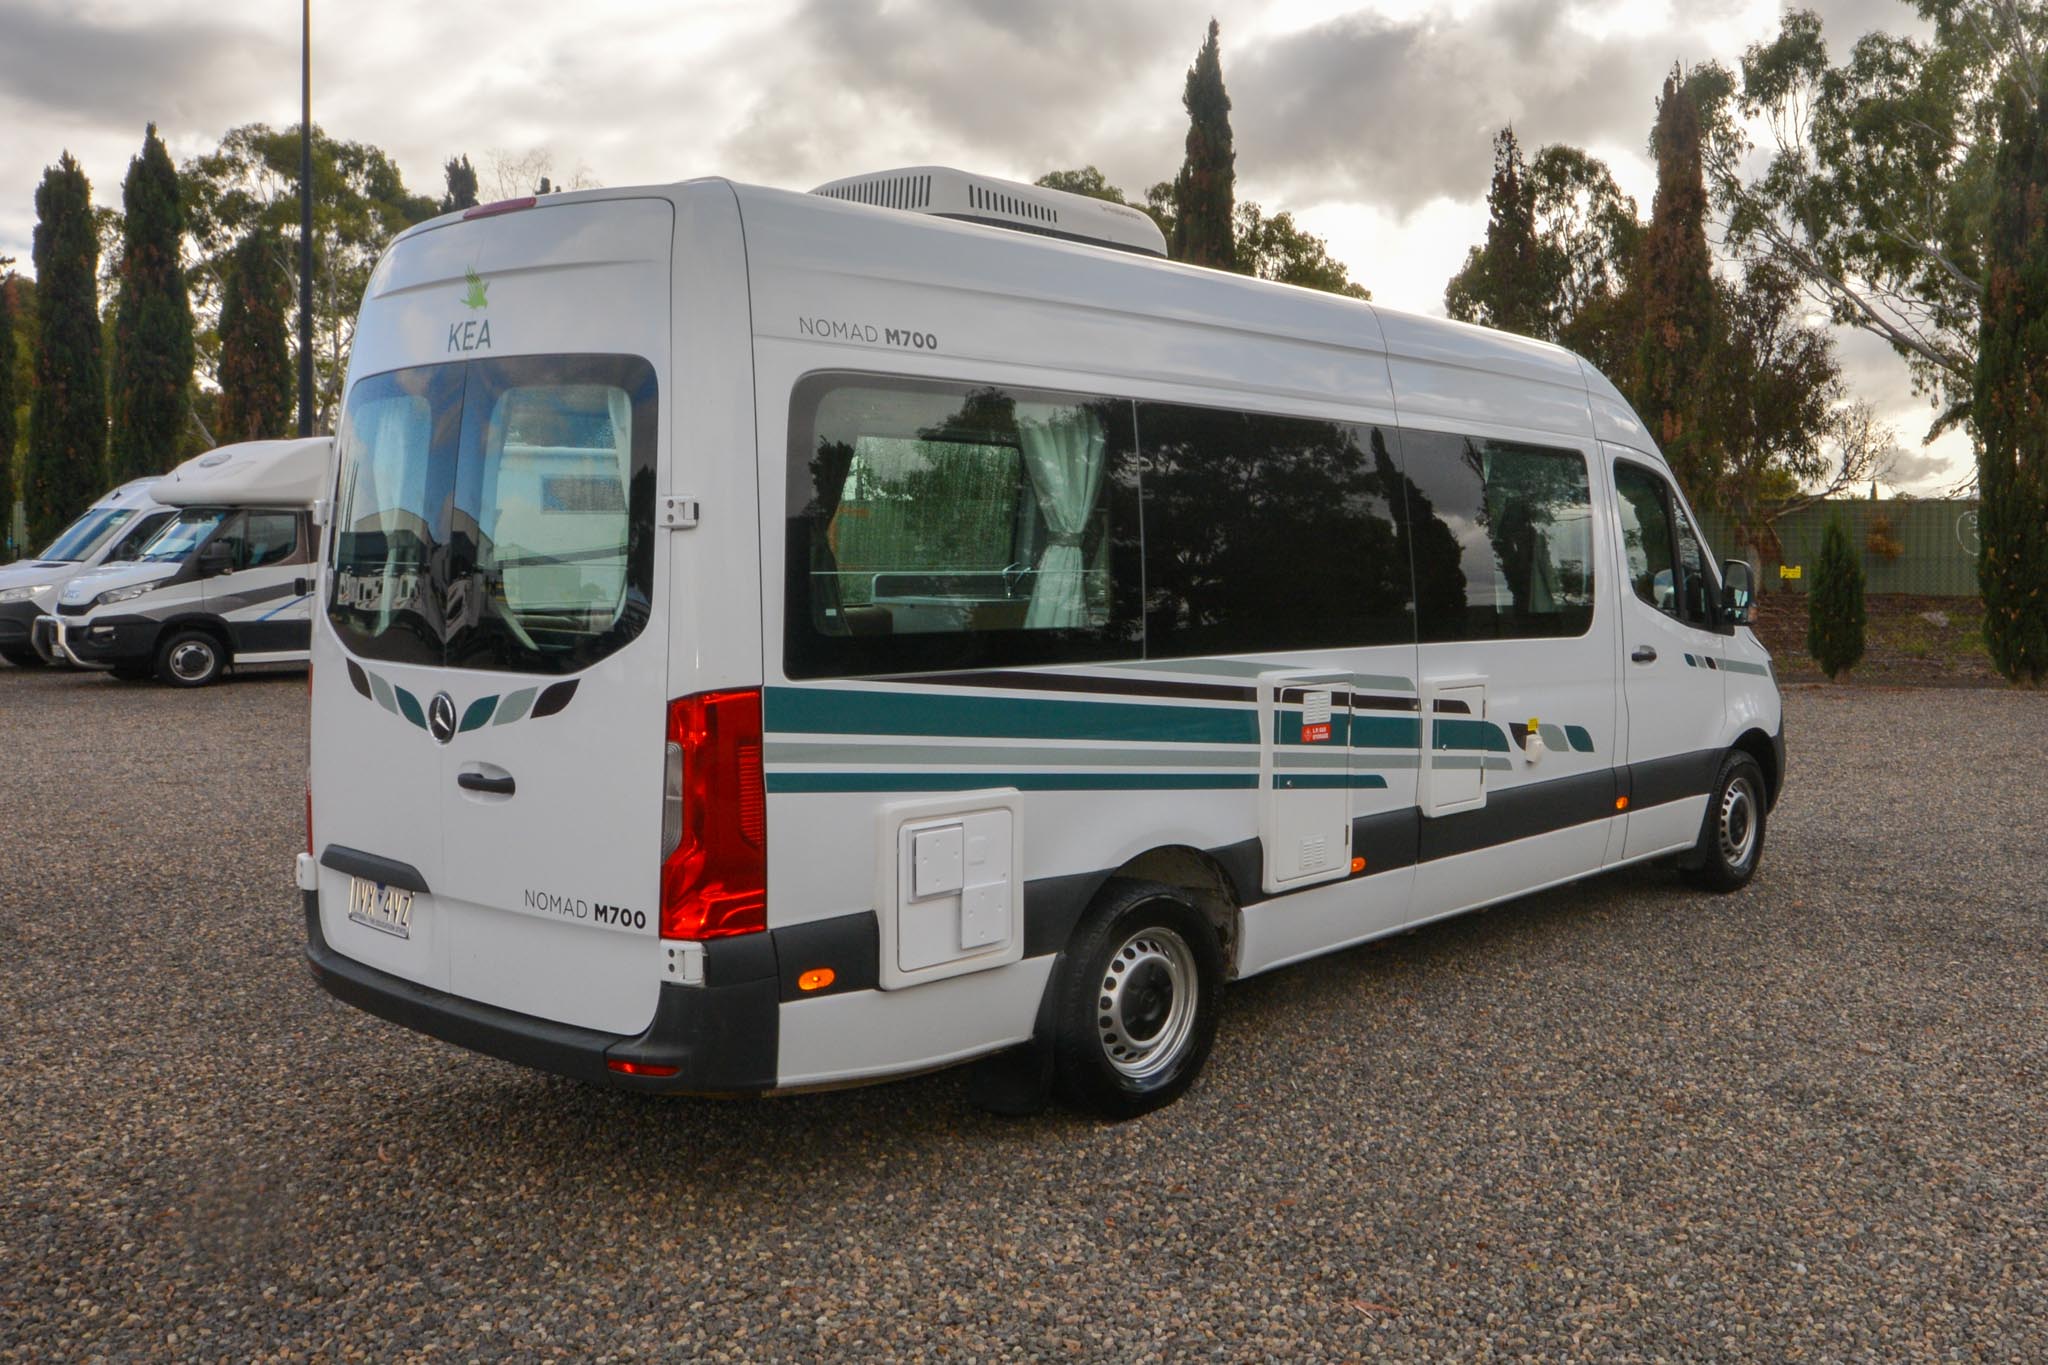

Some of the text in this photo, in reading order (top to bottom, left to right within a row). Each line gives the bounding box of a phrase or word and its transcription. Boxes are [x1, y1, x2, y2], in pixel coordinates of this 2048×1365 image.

[447, 319, 492, 353] KEA
[799, 316, 938, 350] NOMAD M700
[524, 888, 647, 929] NOMAD M700
